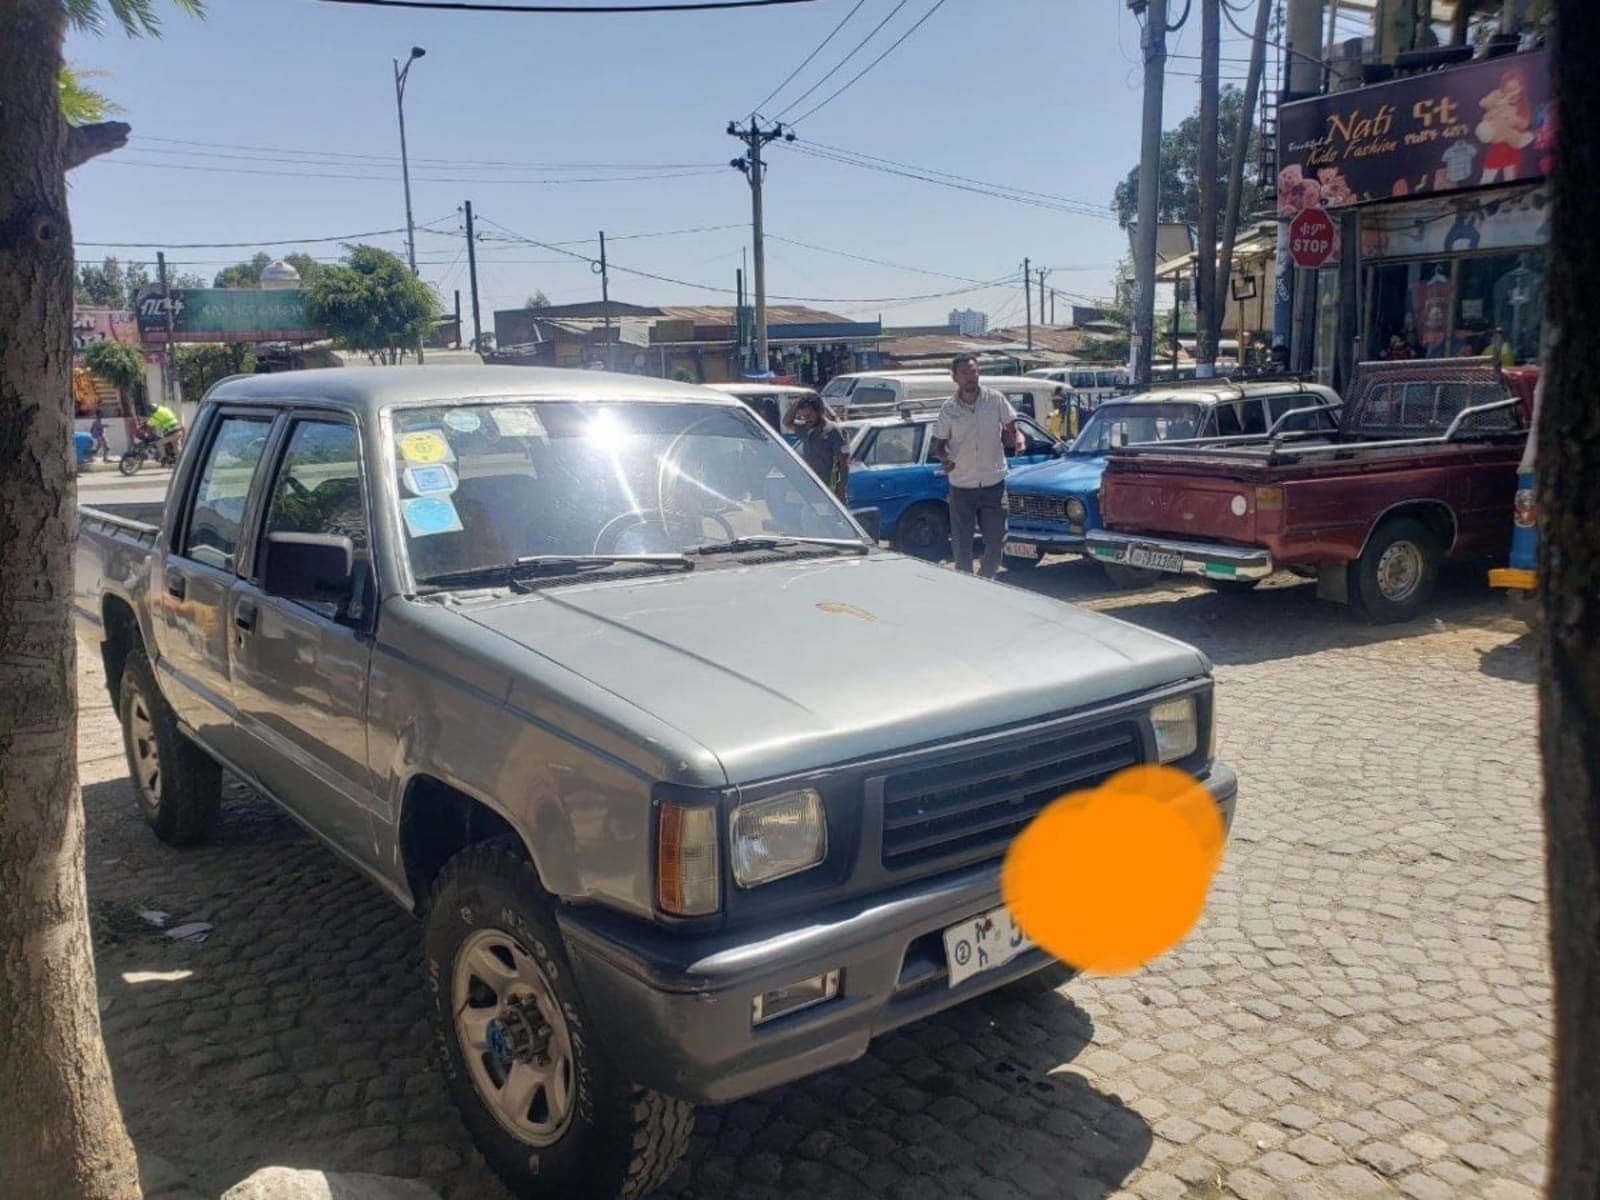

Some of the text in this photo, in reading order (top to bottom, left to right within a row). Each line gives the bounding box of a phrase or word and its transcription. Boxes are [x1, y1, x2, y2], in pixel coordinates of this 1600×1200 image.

[1325, 104, 1396, 145] Nati
[1343, 139, 1397, 159] Fashion
[1293, 239, 1328, 253] STOP
